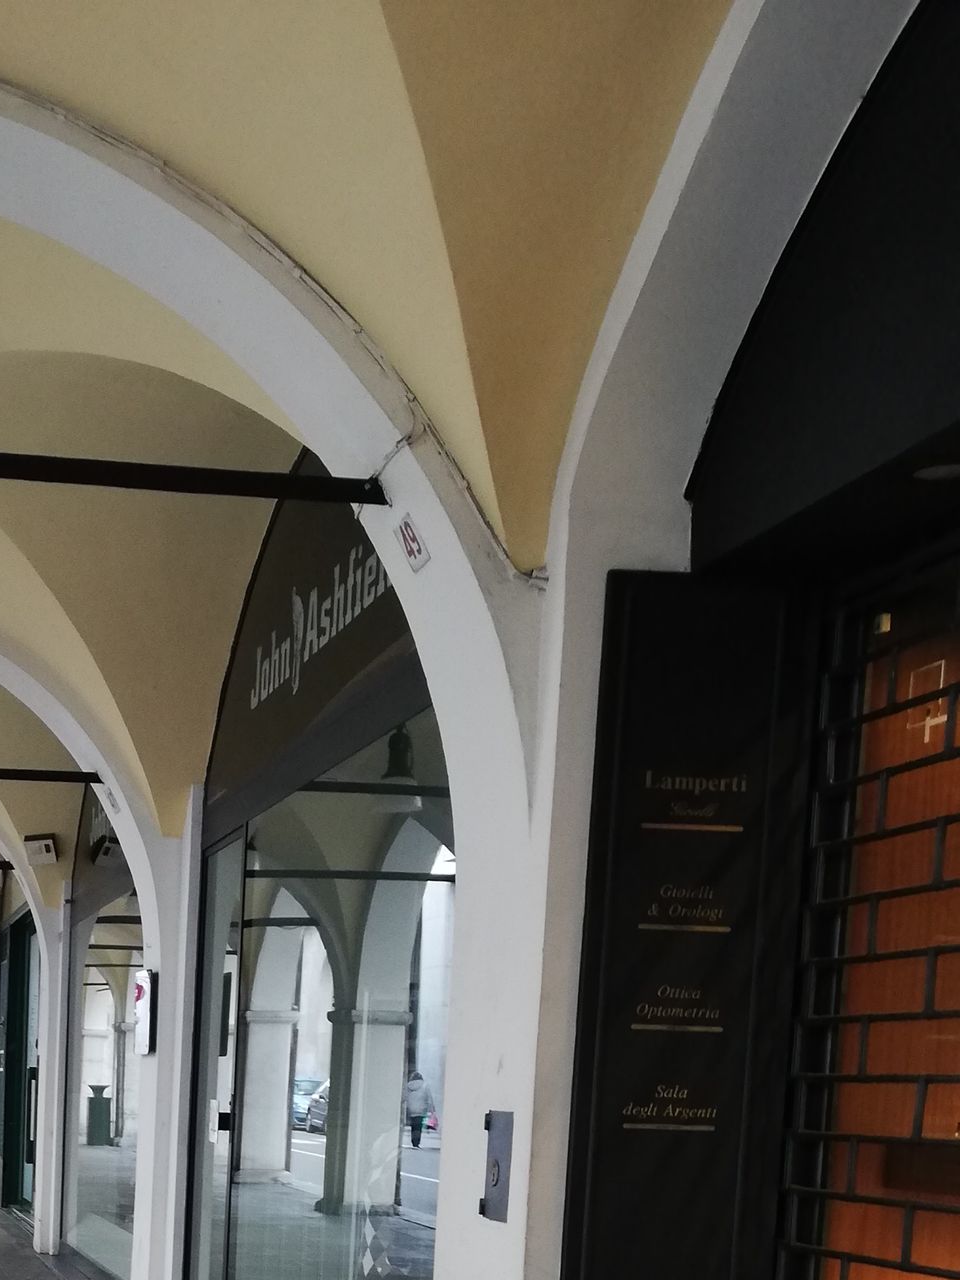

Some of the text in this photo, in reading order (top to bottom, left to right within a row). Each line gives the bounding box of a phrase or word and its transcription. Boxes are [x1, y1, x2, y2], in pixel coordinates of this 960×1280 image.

[399, 520, 422, 560] 49
[250, 630, 291, 710] John
[644, 769, 748, 795] Lamperti
[659, 884, 714, 900] Gioielli
[647, 903, 724, 921] & Orologi
[656, 984, 703, 1000] Ottica
[636, 1003, 721, 1020] Optometria
[655, 1084, 689, 1099] Sala
[622, 1102, 718, 1120] degli Argenti
